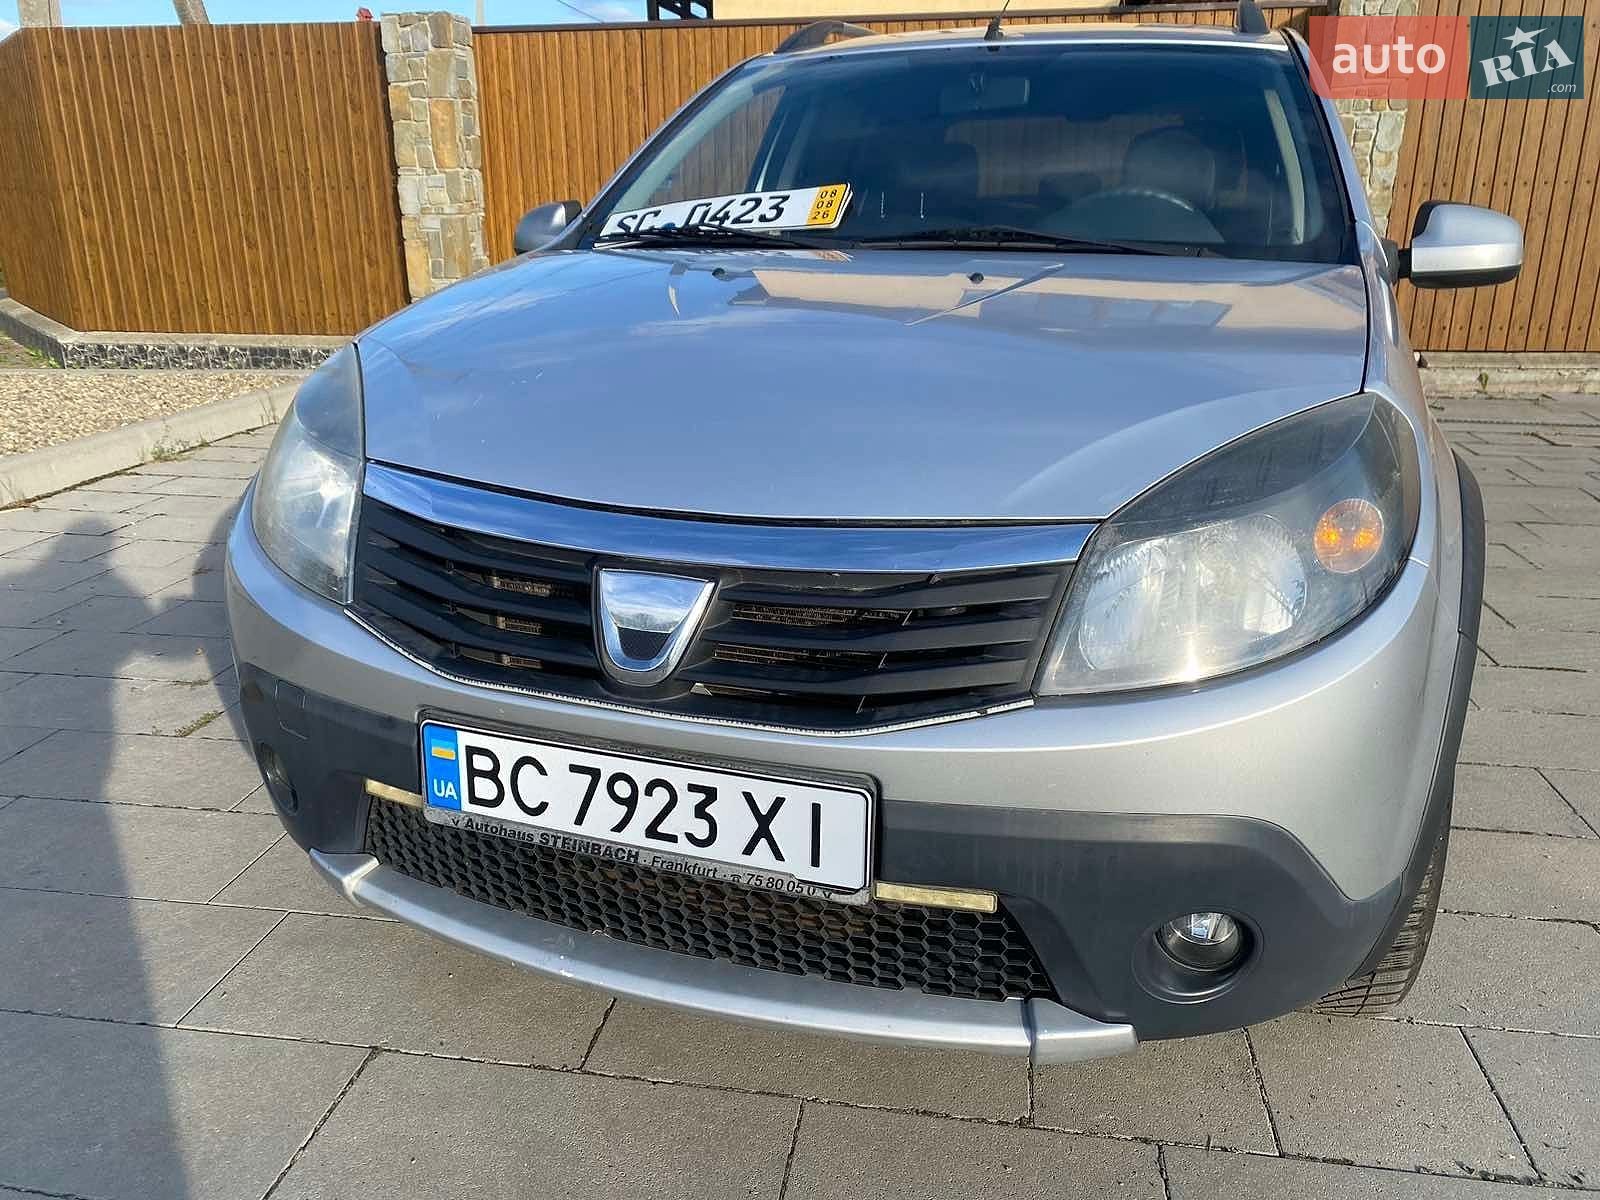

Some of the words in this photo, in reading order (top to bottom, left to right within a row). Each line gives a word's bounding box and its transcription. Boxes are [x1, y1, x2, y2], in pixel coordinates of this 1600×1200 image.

[816, 199, 834, 210] 08
[820, 189, 838, 199] 08
[682, 194, 791, 230] 0423
[811, 209, 829, 220] 26
[433, 778, 458, 800] UA
[465, 744, 550, 817] BC
[568, 763, 718, 849] 7923
[464, 817, 534, 842] Autohaus
[539, 832, 640, 865] STEINBACH
[651, 855, 719, 880] Frankfurt
[746, 873, 764, 887] 75
[765, 875, 784, 890] 80
